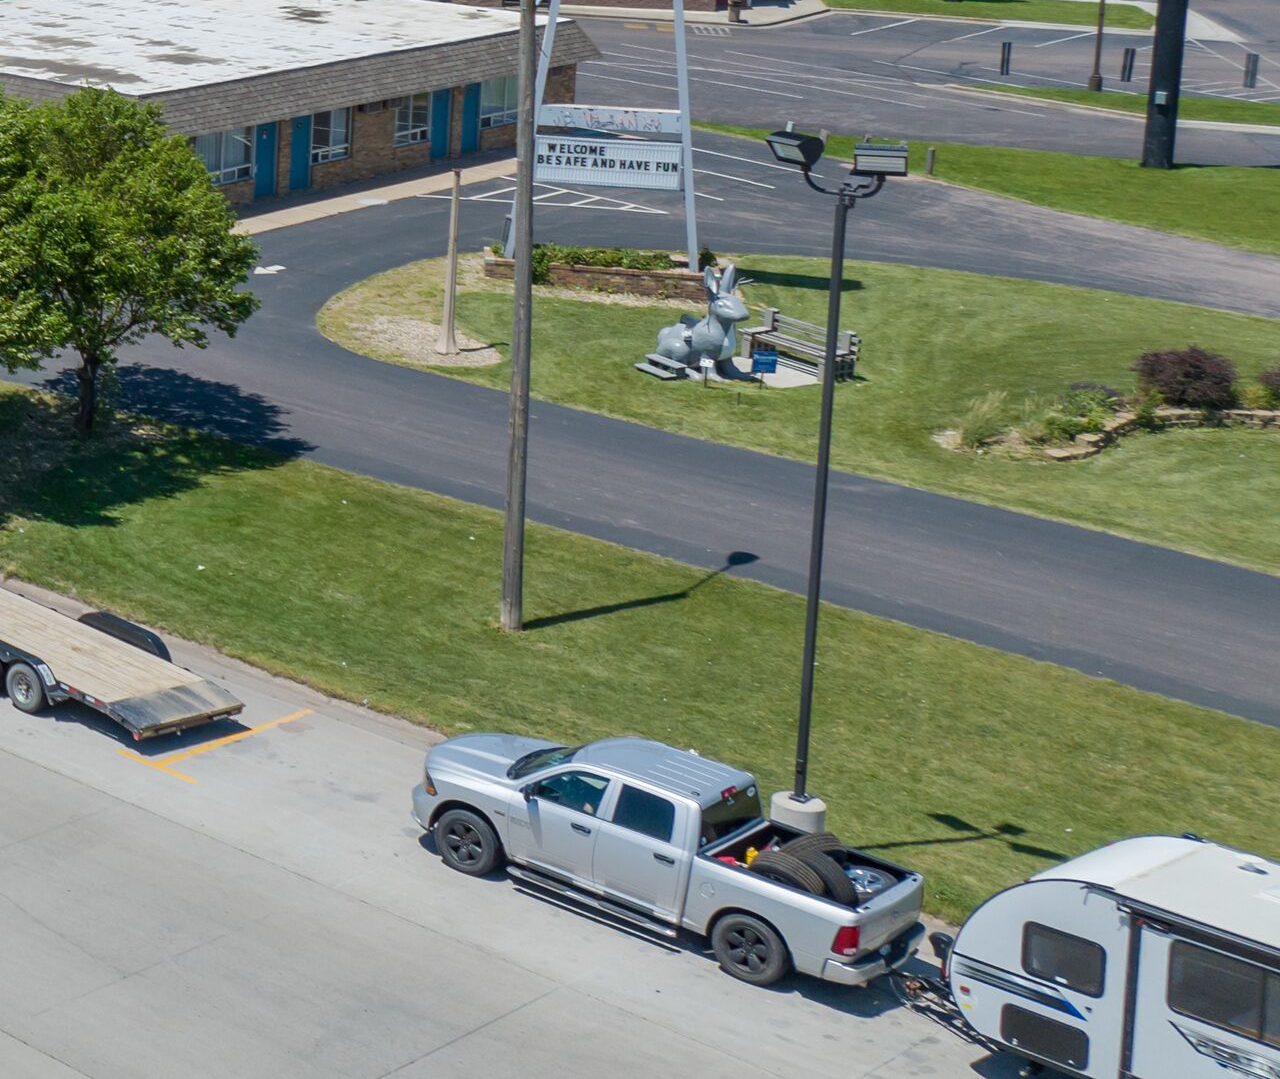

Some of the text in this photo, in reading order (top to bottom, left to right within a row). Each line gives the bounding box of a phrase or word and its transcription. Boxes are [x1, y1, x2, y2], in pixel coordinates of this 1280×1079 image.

[547, 143, 606, 156] WELCOME
[592, 158, 616, 169] AND
[619, 160, 650, 171] HAVE
[655, 162, 679, 172] FUN
